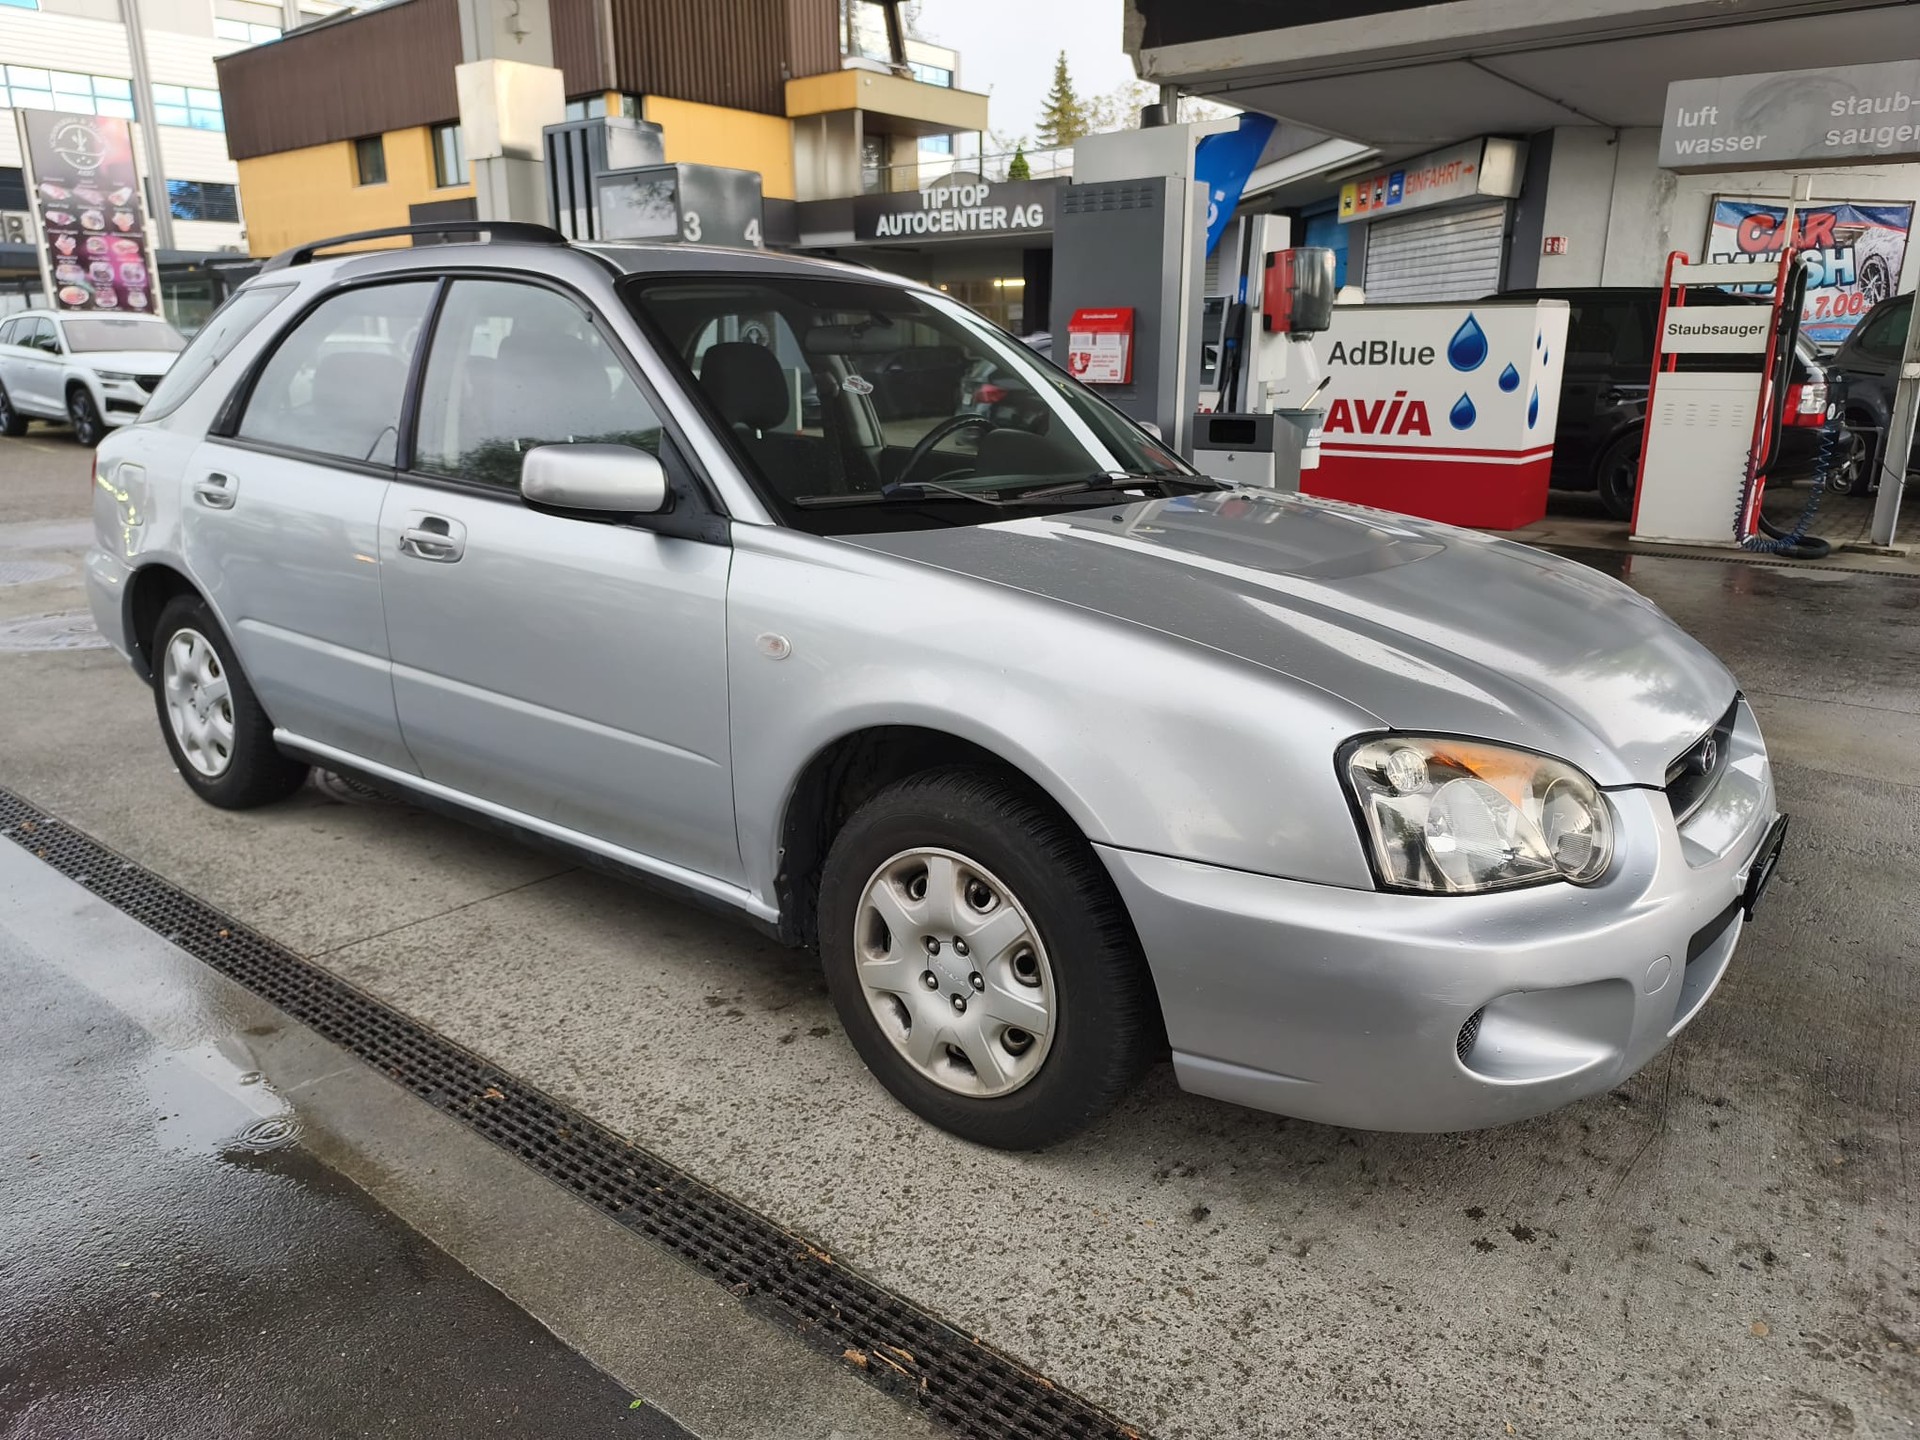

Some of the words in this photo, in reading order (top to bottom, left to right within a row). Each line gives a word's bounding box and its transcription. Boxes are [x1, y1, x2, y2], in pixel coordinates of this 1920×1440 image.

[1676, 106, 1719, 127] luft
[1674, 135, 1768, 155] wasser
[1404, 161, 1463, 196] EINFAHRT
[919, 184, 990, 210] TIPTOP
[683, 211, 702, 242] 3
[743, 218, 762, 248] 4
[875, 206, 1008, 237] AUTOCENTER
[1010, 203, 1044, 229] AG
[1737, 212, 1838, 253] CAR
[1815, 291, 1864, 319] 7.00
[1667, 323, 1766, 338] Staubsauger
[1327, 340, 1436, 366] AdBlue
